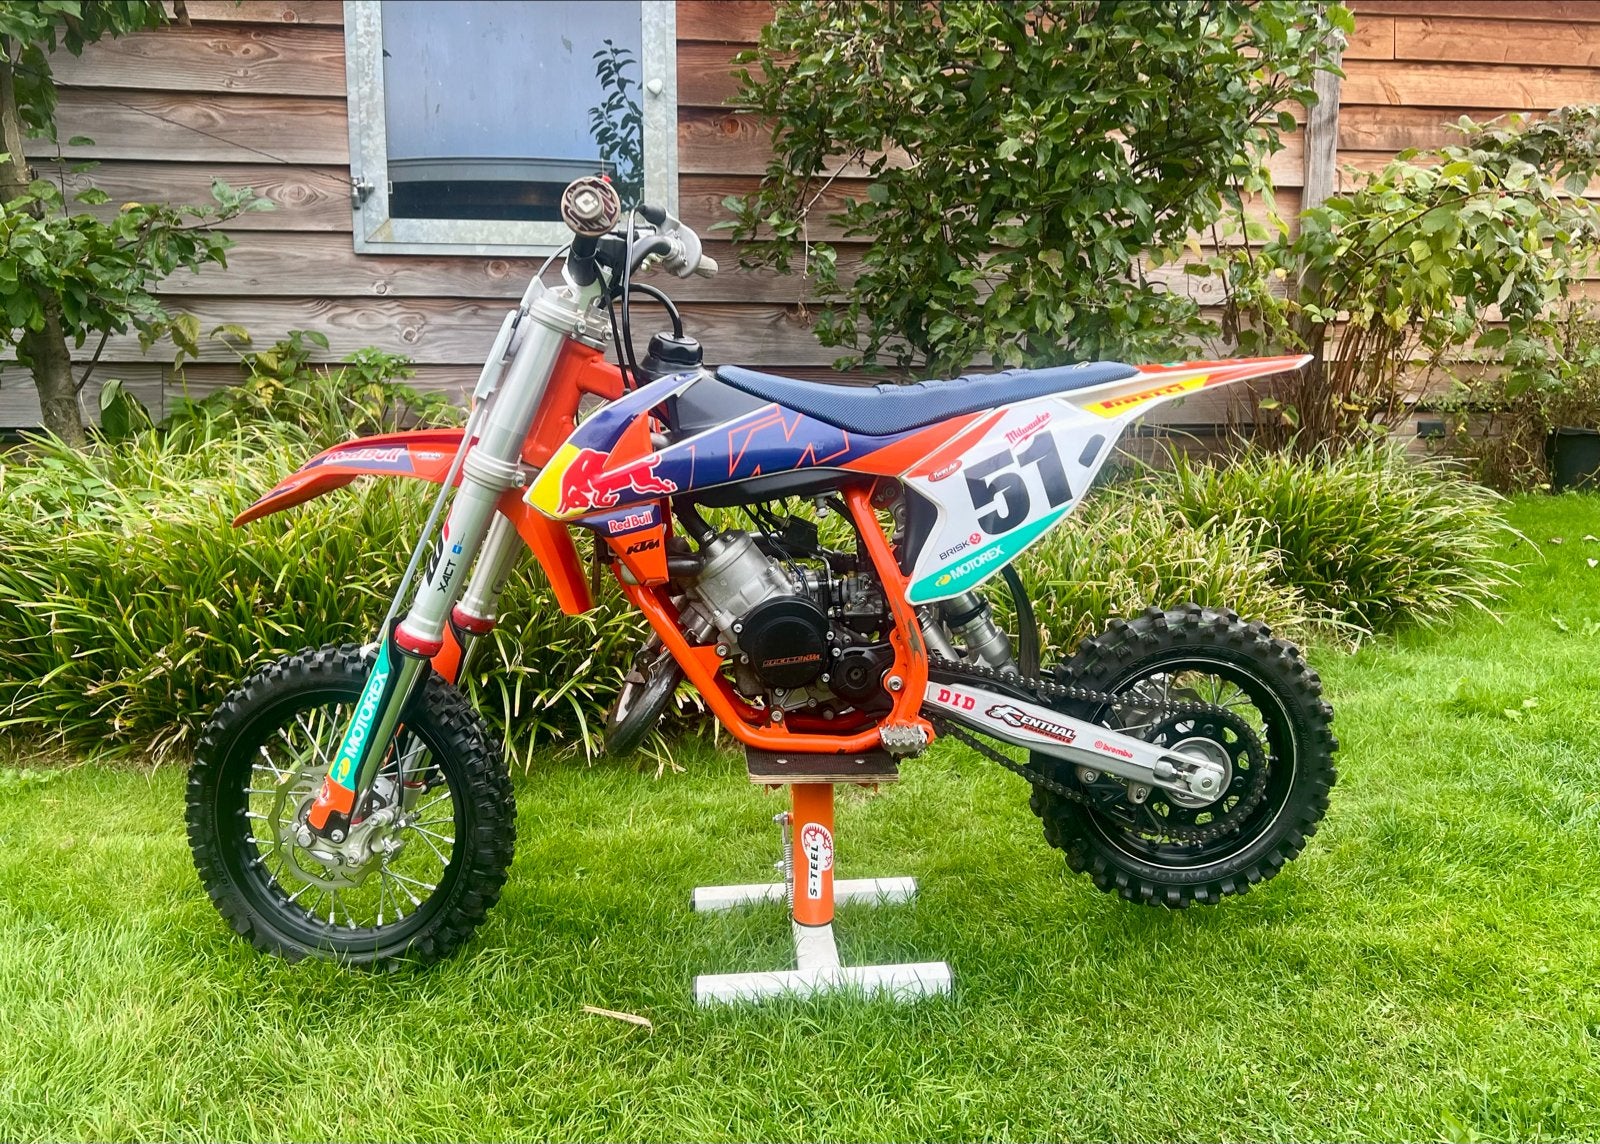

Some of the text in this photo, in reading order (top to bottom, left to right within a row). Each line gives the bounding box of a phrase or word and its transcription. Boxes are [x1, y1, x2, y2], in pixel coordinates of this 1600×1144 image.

[1004, 412, 1052, 445] Milwaukee
[963, 430, 1073, 535] 51
[626, 539, 660, 555] KTM
[939, 541, 971, 560] BRISK
[950, 544, 1006, 580] MOTOREX
[437, 559, 457, 593] XACT
[344, 669, 389, 759] MOTOREX
[1103, 743, 1134, 759] brembo
[809, 845, 819, 896] S-TEEL
